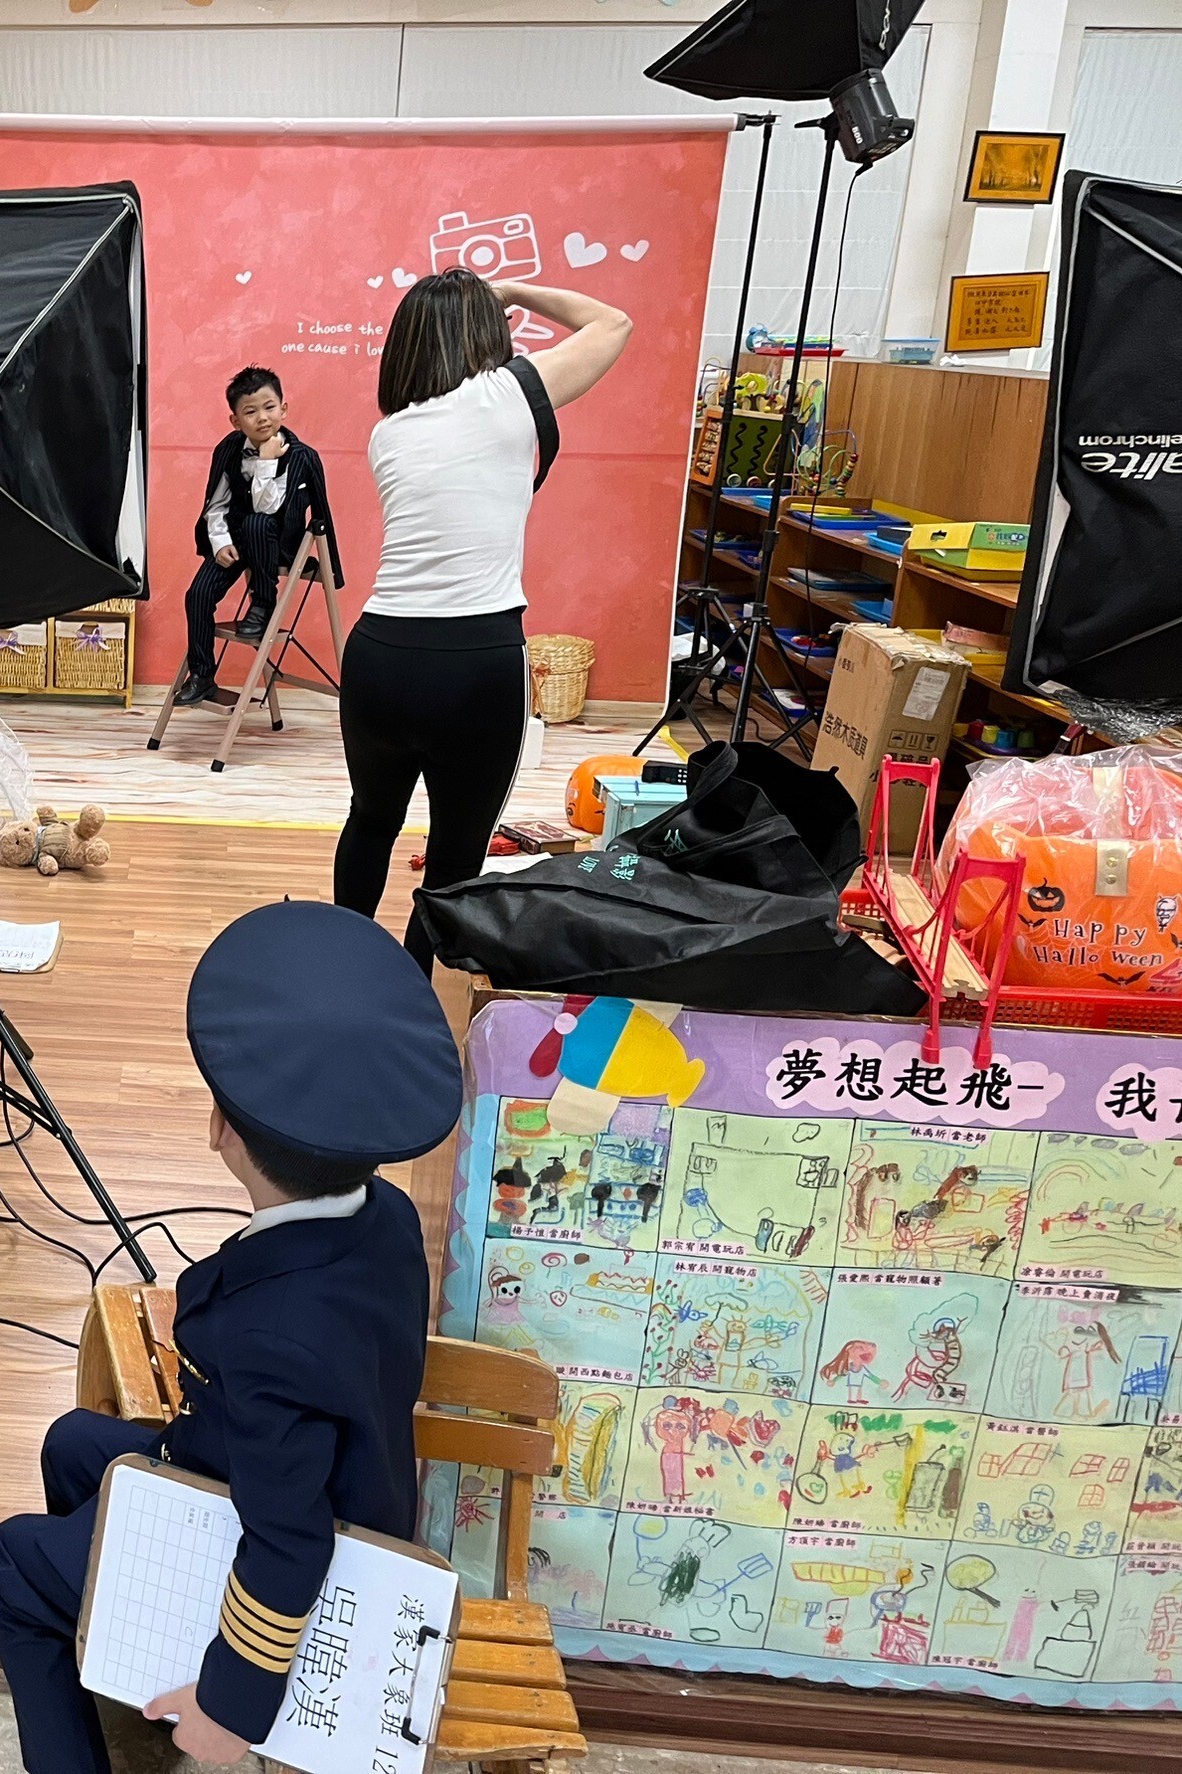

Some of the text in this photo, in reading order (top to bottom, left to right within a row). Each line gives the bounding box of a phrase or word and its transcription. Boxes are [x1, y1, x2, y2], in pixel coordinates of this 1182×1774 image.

[297, 321, 384, 335] I choose the
[281, 341, 305, 353] one
[308, 343, 347, 355] cause
